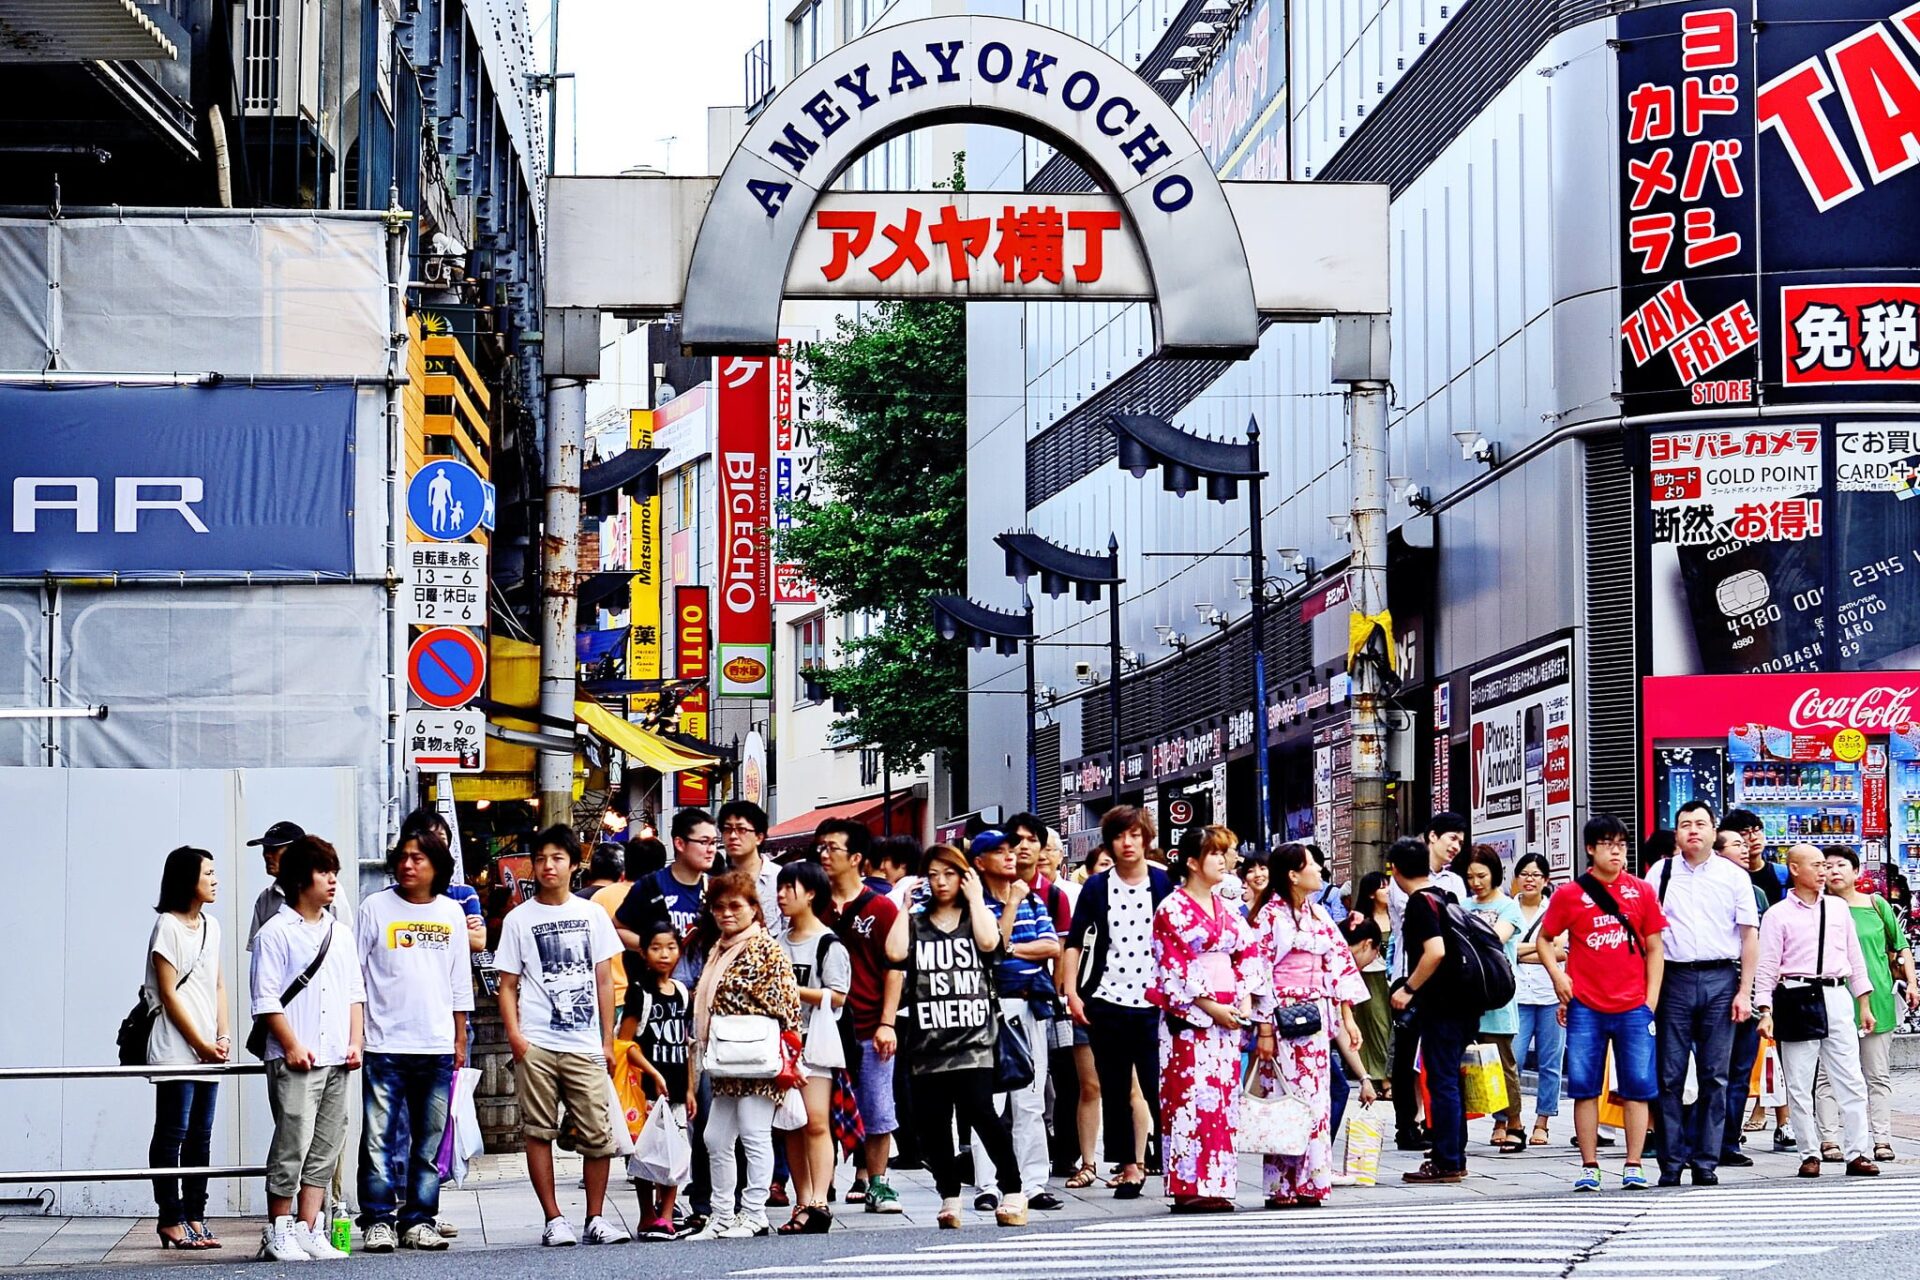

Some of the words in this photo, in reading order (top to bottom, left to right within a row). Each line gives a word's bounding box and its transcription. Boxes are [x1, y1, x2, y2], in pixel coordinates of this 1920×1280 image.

[1758, 0, 1920, 213] TA
[745, 40, 1195, 219] AMEYAYOKOCHO
[1681, 7, 1743, 269] ヨドバシ
[1627, 82, 1677, 274] カメラ
[817, 204, 1122, 284] アメヤ横丁
[1621, 280, 1703, 368] TAX
[1668, 299, 1760, 387] FREE
[1792, 299, 1920, 373] 免税
[1692, 379, 1752, 405] STORE
[1651, 429, 1820, 464] ヨドバシカメラ
[724, 452, 755, 515] BIG
[758, 467, 768, 511] Karaoke
[1653, 470, 1698, 487] 他カード
[1664, 485, 1686, 499] より
[1706, 467, 1756, 486] GOLD
[1761, 464, 1819, 483] POINT
[1837, 463, 1889, 480] CARD
[12, 476, 211, 534] AR
[413, 550, 479, 567] 自転車を除く
[726, 521, 756, 614] ECHO
[1706, 539, 1743, 562] GOLD
[415, 587, 476, 603] 日曜・休日は
[1726, 603, 1783, 637] 4980
[1849, 555, 1905, 588] 2345
[1838, 599, 1887, 626] 00/00
[1742, 641, 1823, 674] ODOBASH
[1838, 619, 1875, 644] ARO
[1789, 686, 1919, 729] Coca-Cola
[411, 736, 478, 752] 貨物を除く
[1487, 748, 1517, 788] Android
[916, 937, 984, 971] MUSI
[929, 972, 950, 996] IS
[953, 970, 981, 995] MY
